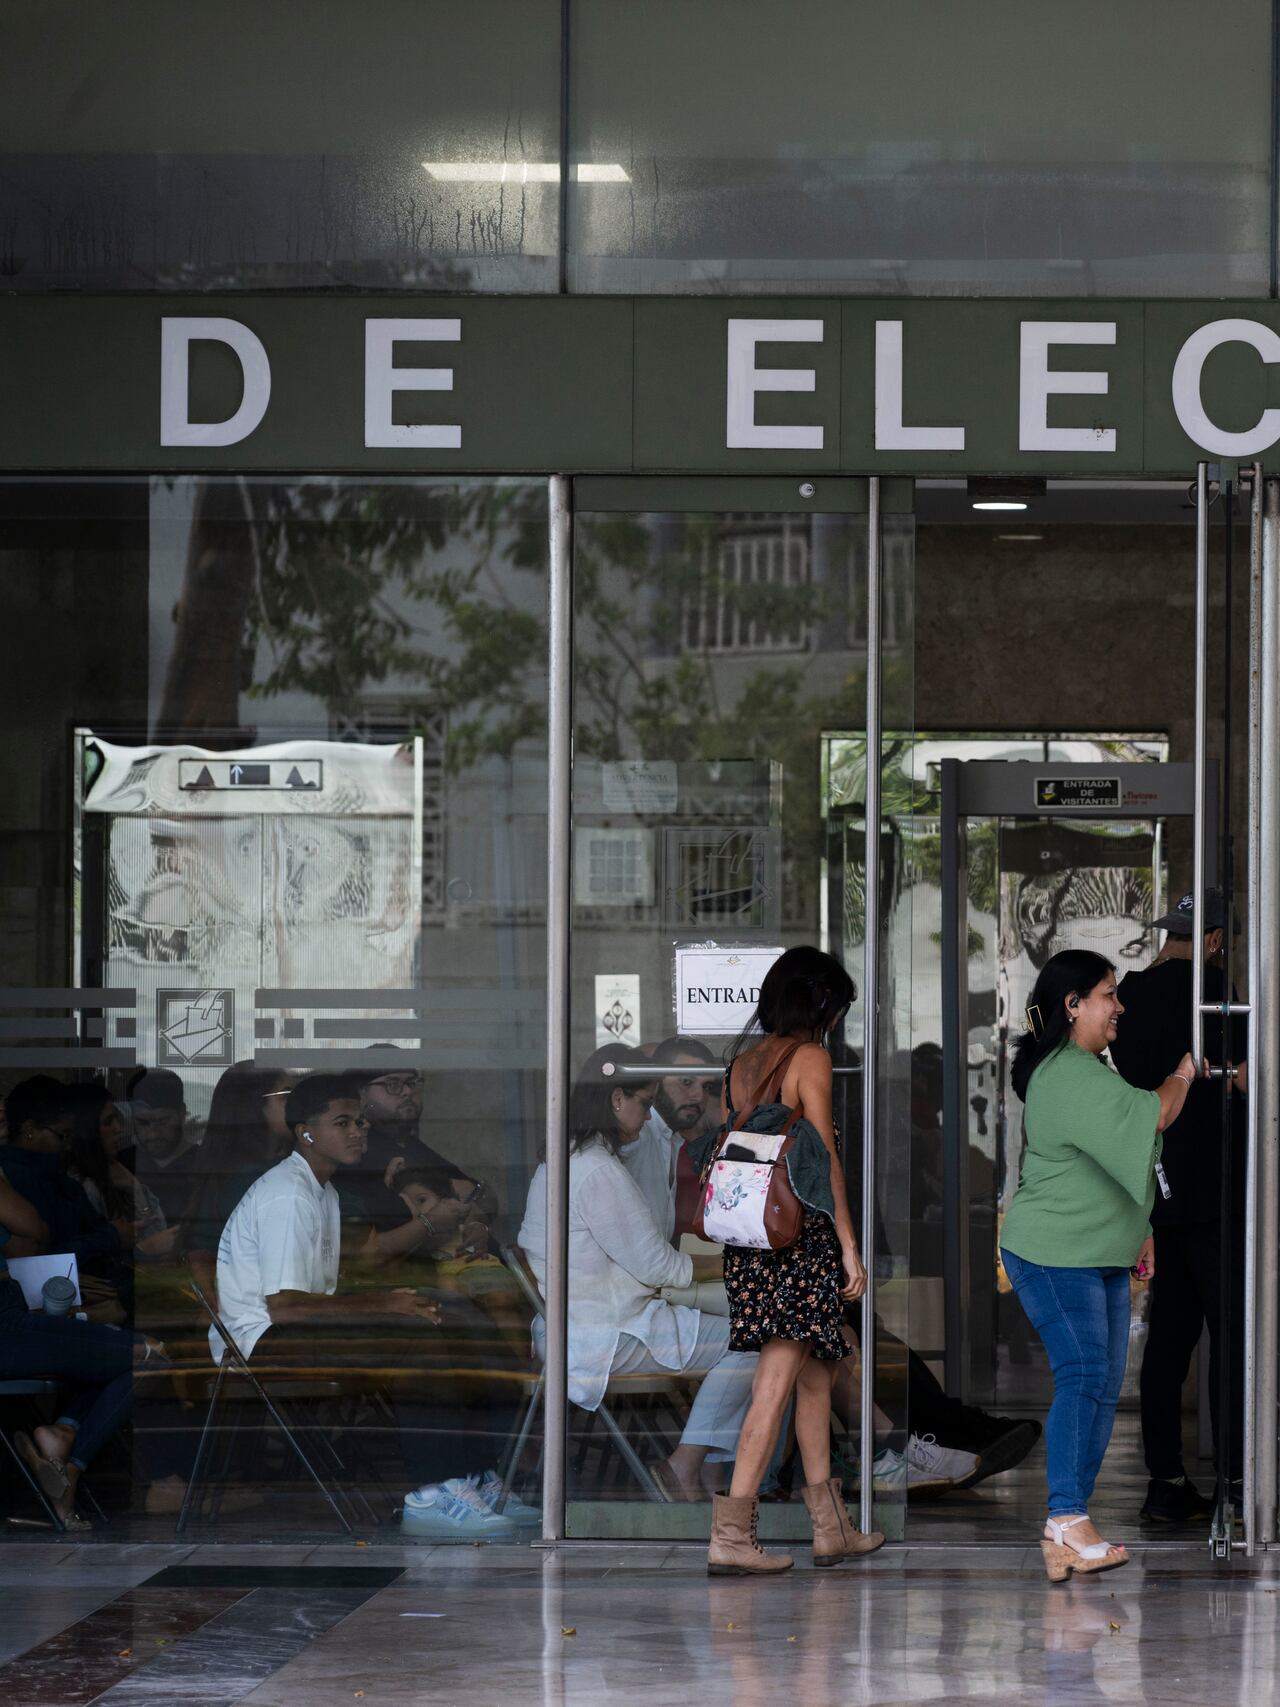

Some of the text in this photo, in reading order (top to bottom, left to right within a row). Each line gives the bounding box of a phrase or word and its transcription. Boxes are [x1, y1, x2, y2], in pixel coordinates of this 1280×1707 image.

[161, 318, 462, 448] DE
[1063, 780, 1112, 788] ENTRADA
[1080, 789, 1095, 797] DE
[1060, 798, 1119, 806] VISITANTES
[687, 988, 761, 1003] ENTRAD
